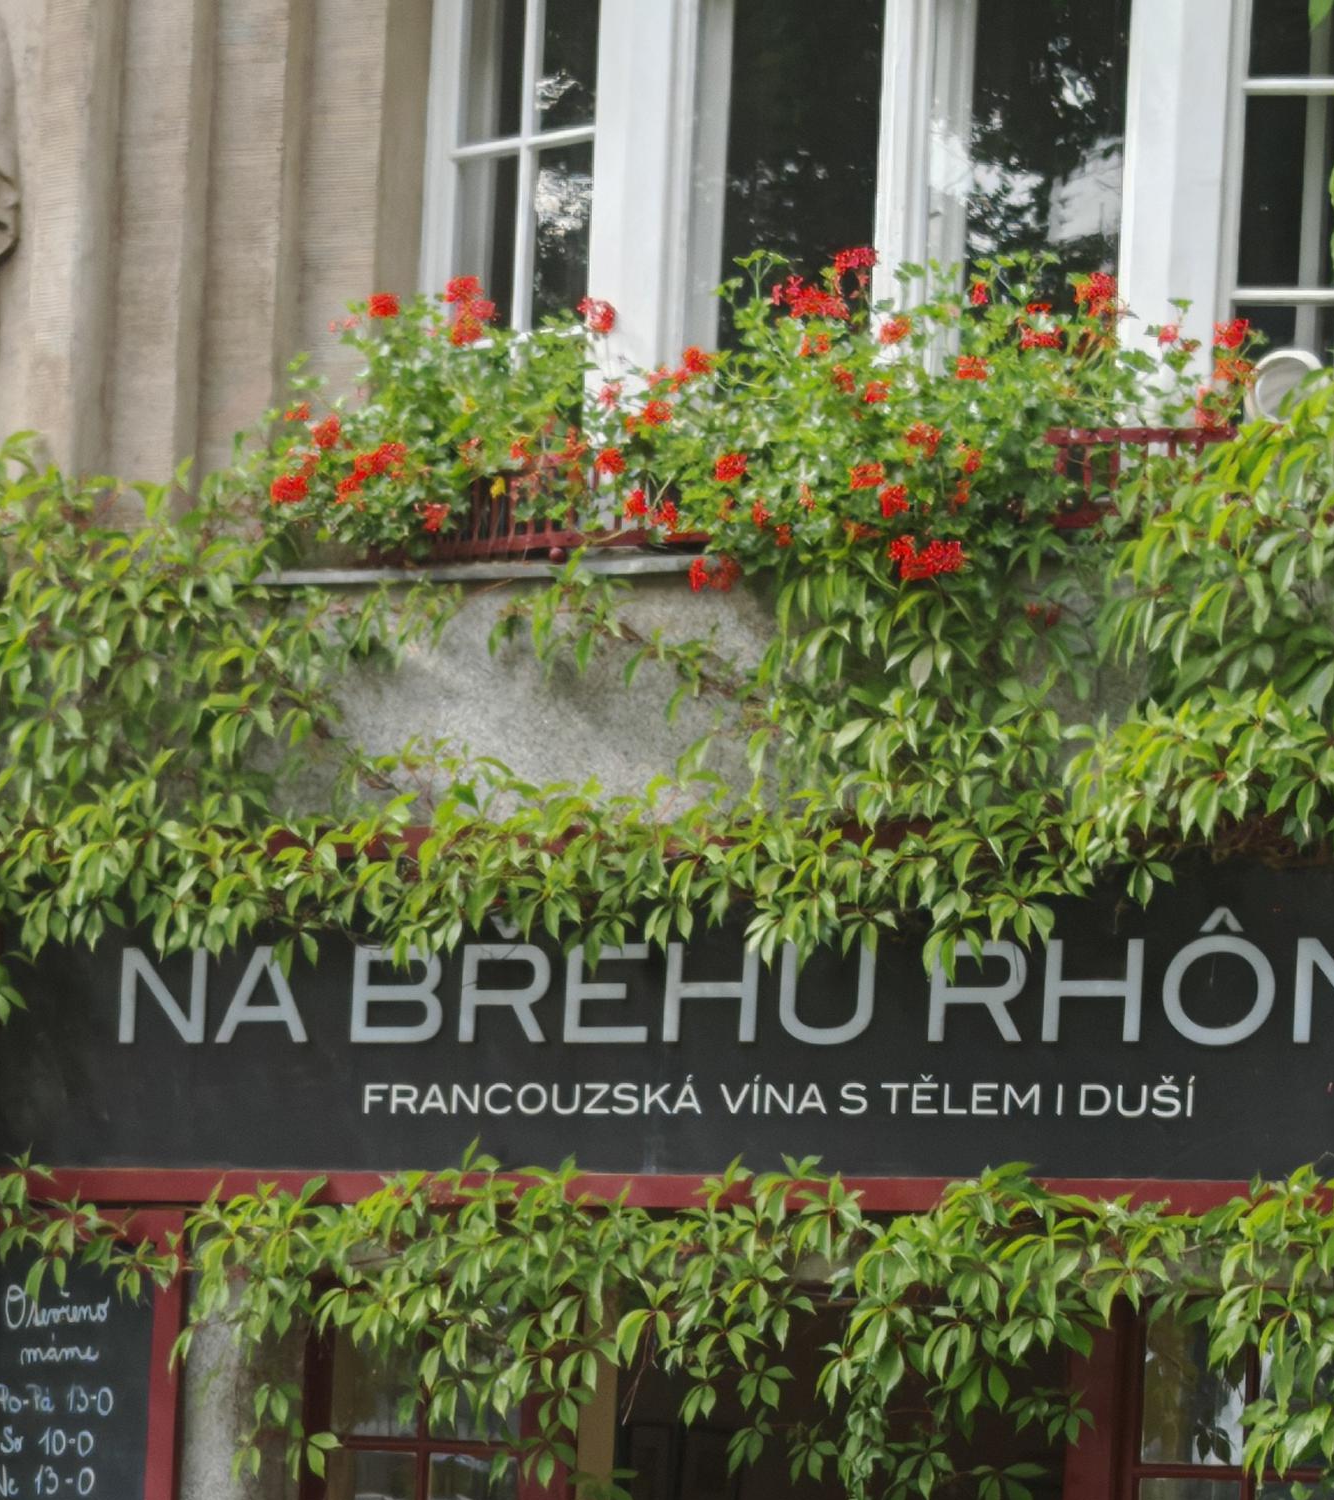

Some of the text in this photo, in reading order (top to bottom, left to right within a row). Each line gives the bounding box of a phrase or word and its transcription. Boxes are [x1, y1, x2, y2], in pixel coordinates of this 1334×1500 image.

[117, 946, 308, 1044] NA
[349, 912, 877, 1046] BŘEHU
[362, 1073, 1197, 1118] FRANCOUZSKÁ VÍNA S TĚLEM I DUŠÍ
